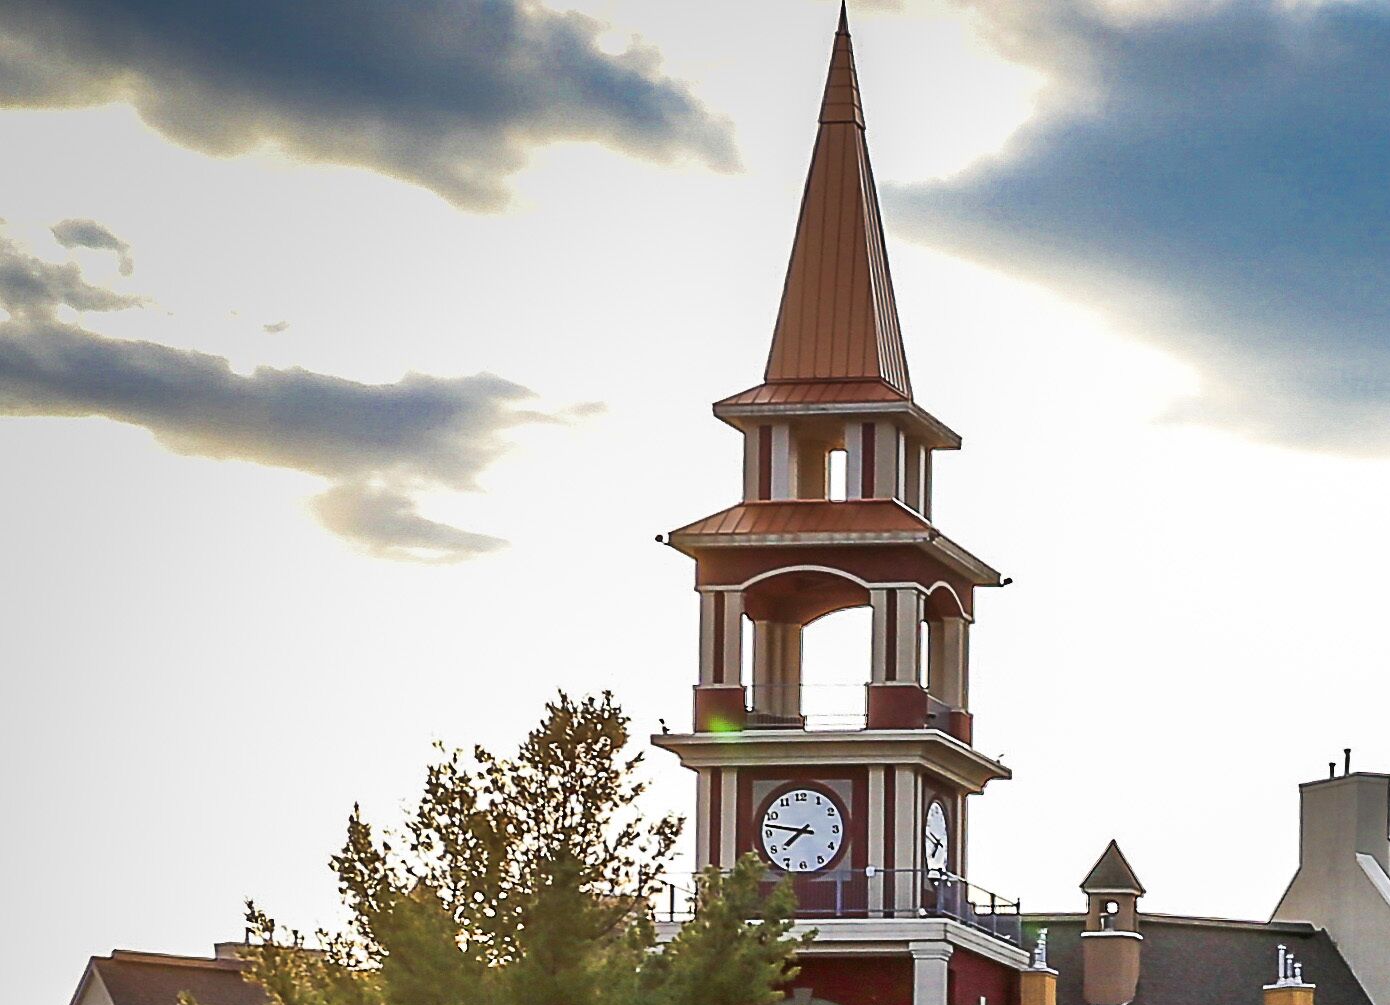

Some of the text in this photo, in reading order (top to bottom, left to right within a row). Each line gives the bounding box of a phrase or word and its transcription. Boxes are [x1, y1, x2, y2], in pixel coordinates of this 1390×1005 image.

[795, 792, 807, 802] 12
[816, 796, 821, 805] 1
[780, 798, 789, 807] 11
[766, 811, 778, 821] 10
[827, 807, 834, 816] 2
[765, 829, 773, 838] 9
[832, 825, 839, 834] 3
[770, 845, 778, 854] 8
[828, 841, 835, 850] 4
[783, 857, 790, 867] 7
[817, 855, 824, 864] 5
[799, 860, 807, 869] 6
